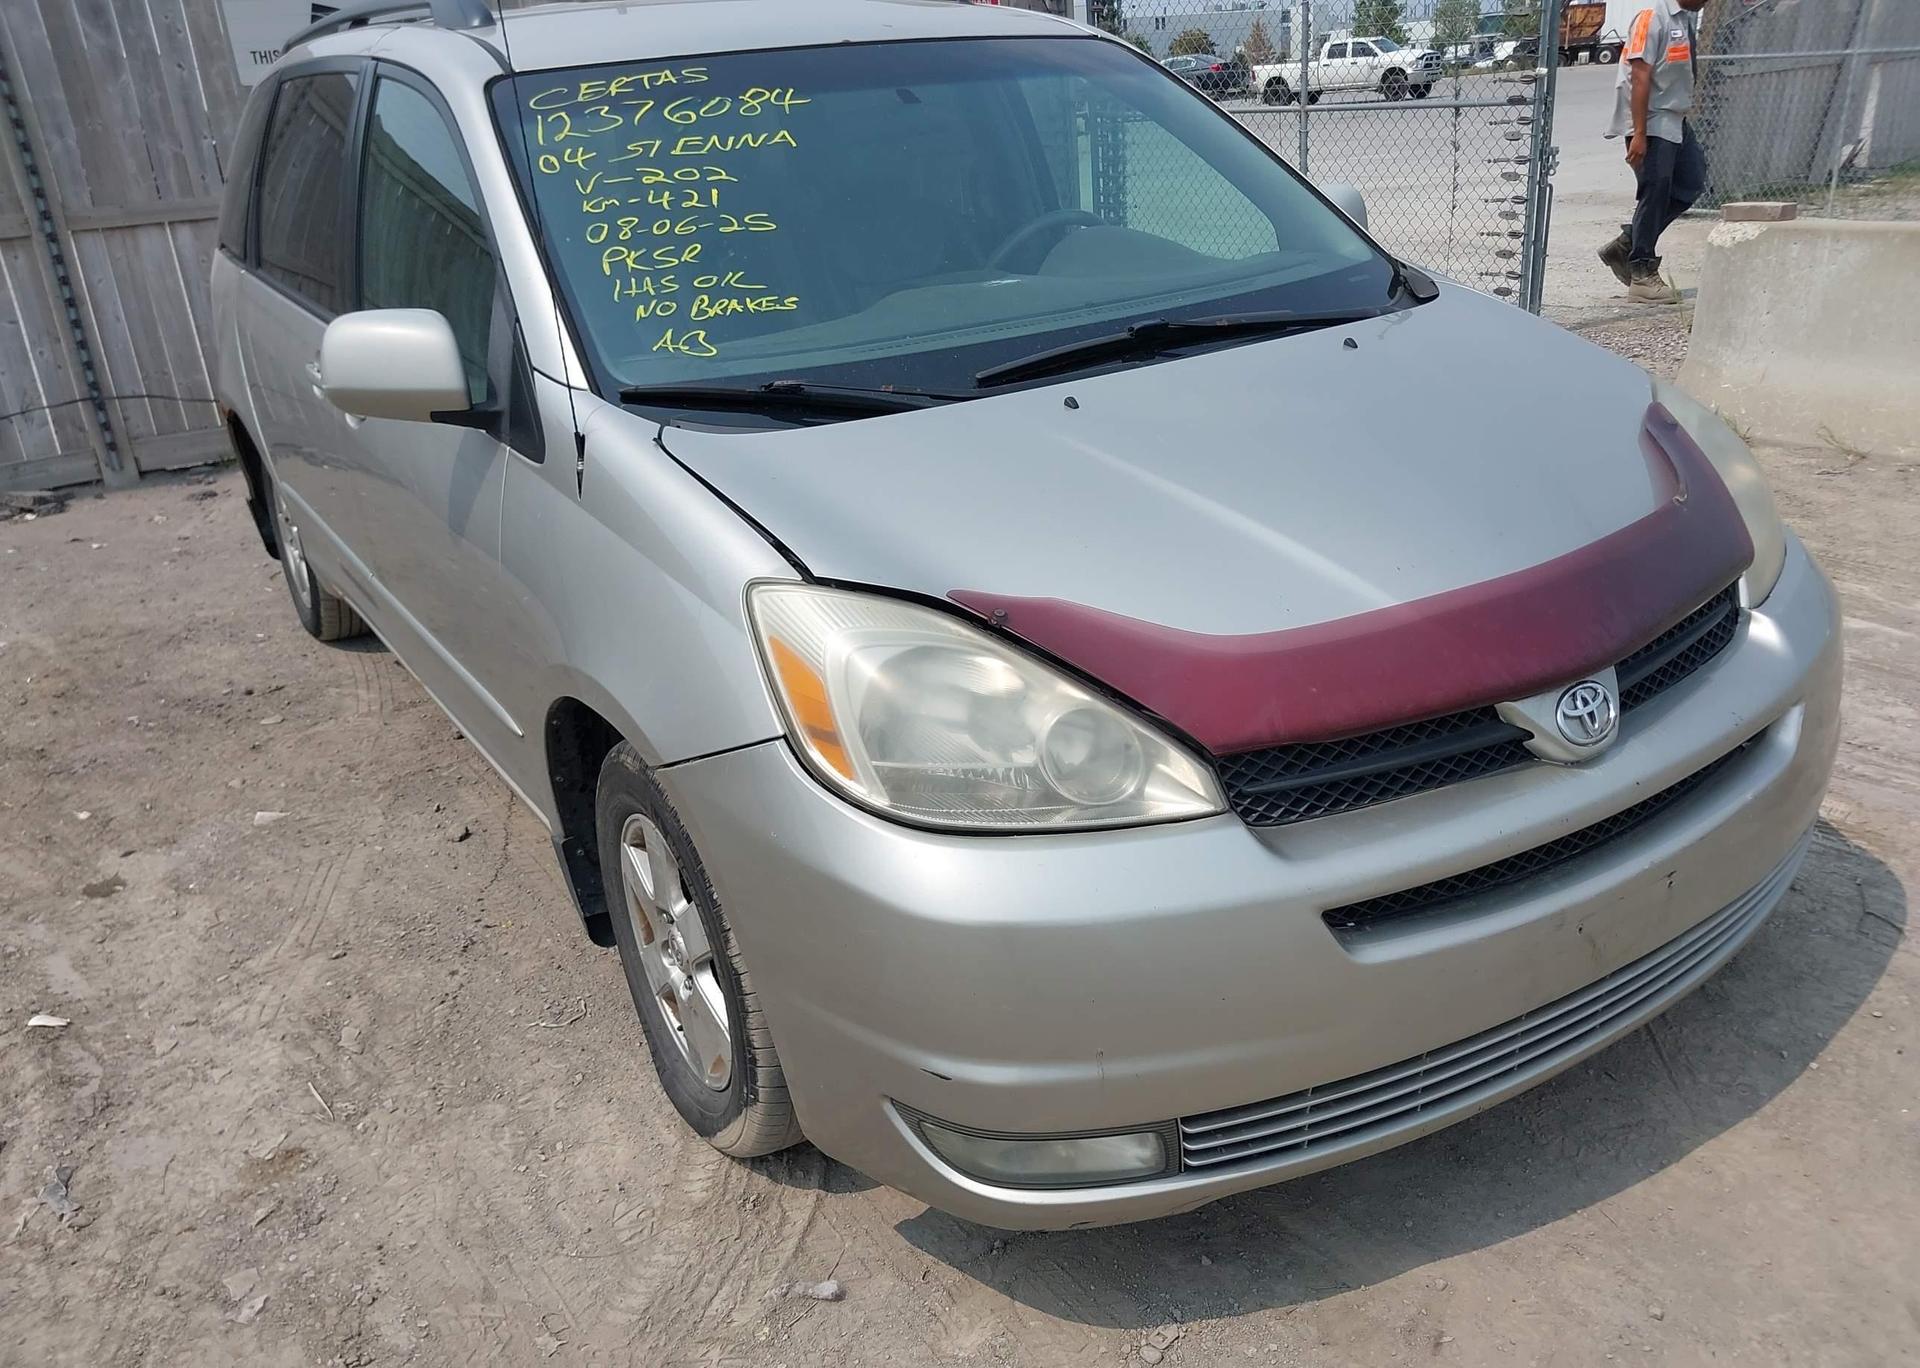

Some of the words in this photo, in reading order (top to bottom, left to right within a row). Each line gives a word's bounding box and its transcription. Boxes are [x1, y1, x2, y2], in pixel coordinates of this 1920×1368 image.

[250, 50, 280, 64] THIS
[529, 68, 708, 109] CERTAS
[536, 87, 811, 145] 12376084
[538, 147, 596, 173] 04
[607, 129, 797, 162] SIENNA
[586, 213, 776, 243] 08-06-25
[614, 275, 680, 302] HAS
[693, 272, 767, 288] OK
[636, 300, 676, 322] NO
[690, 295, 799, 320] BRAKES
